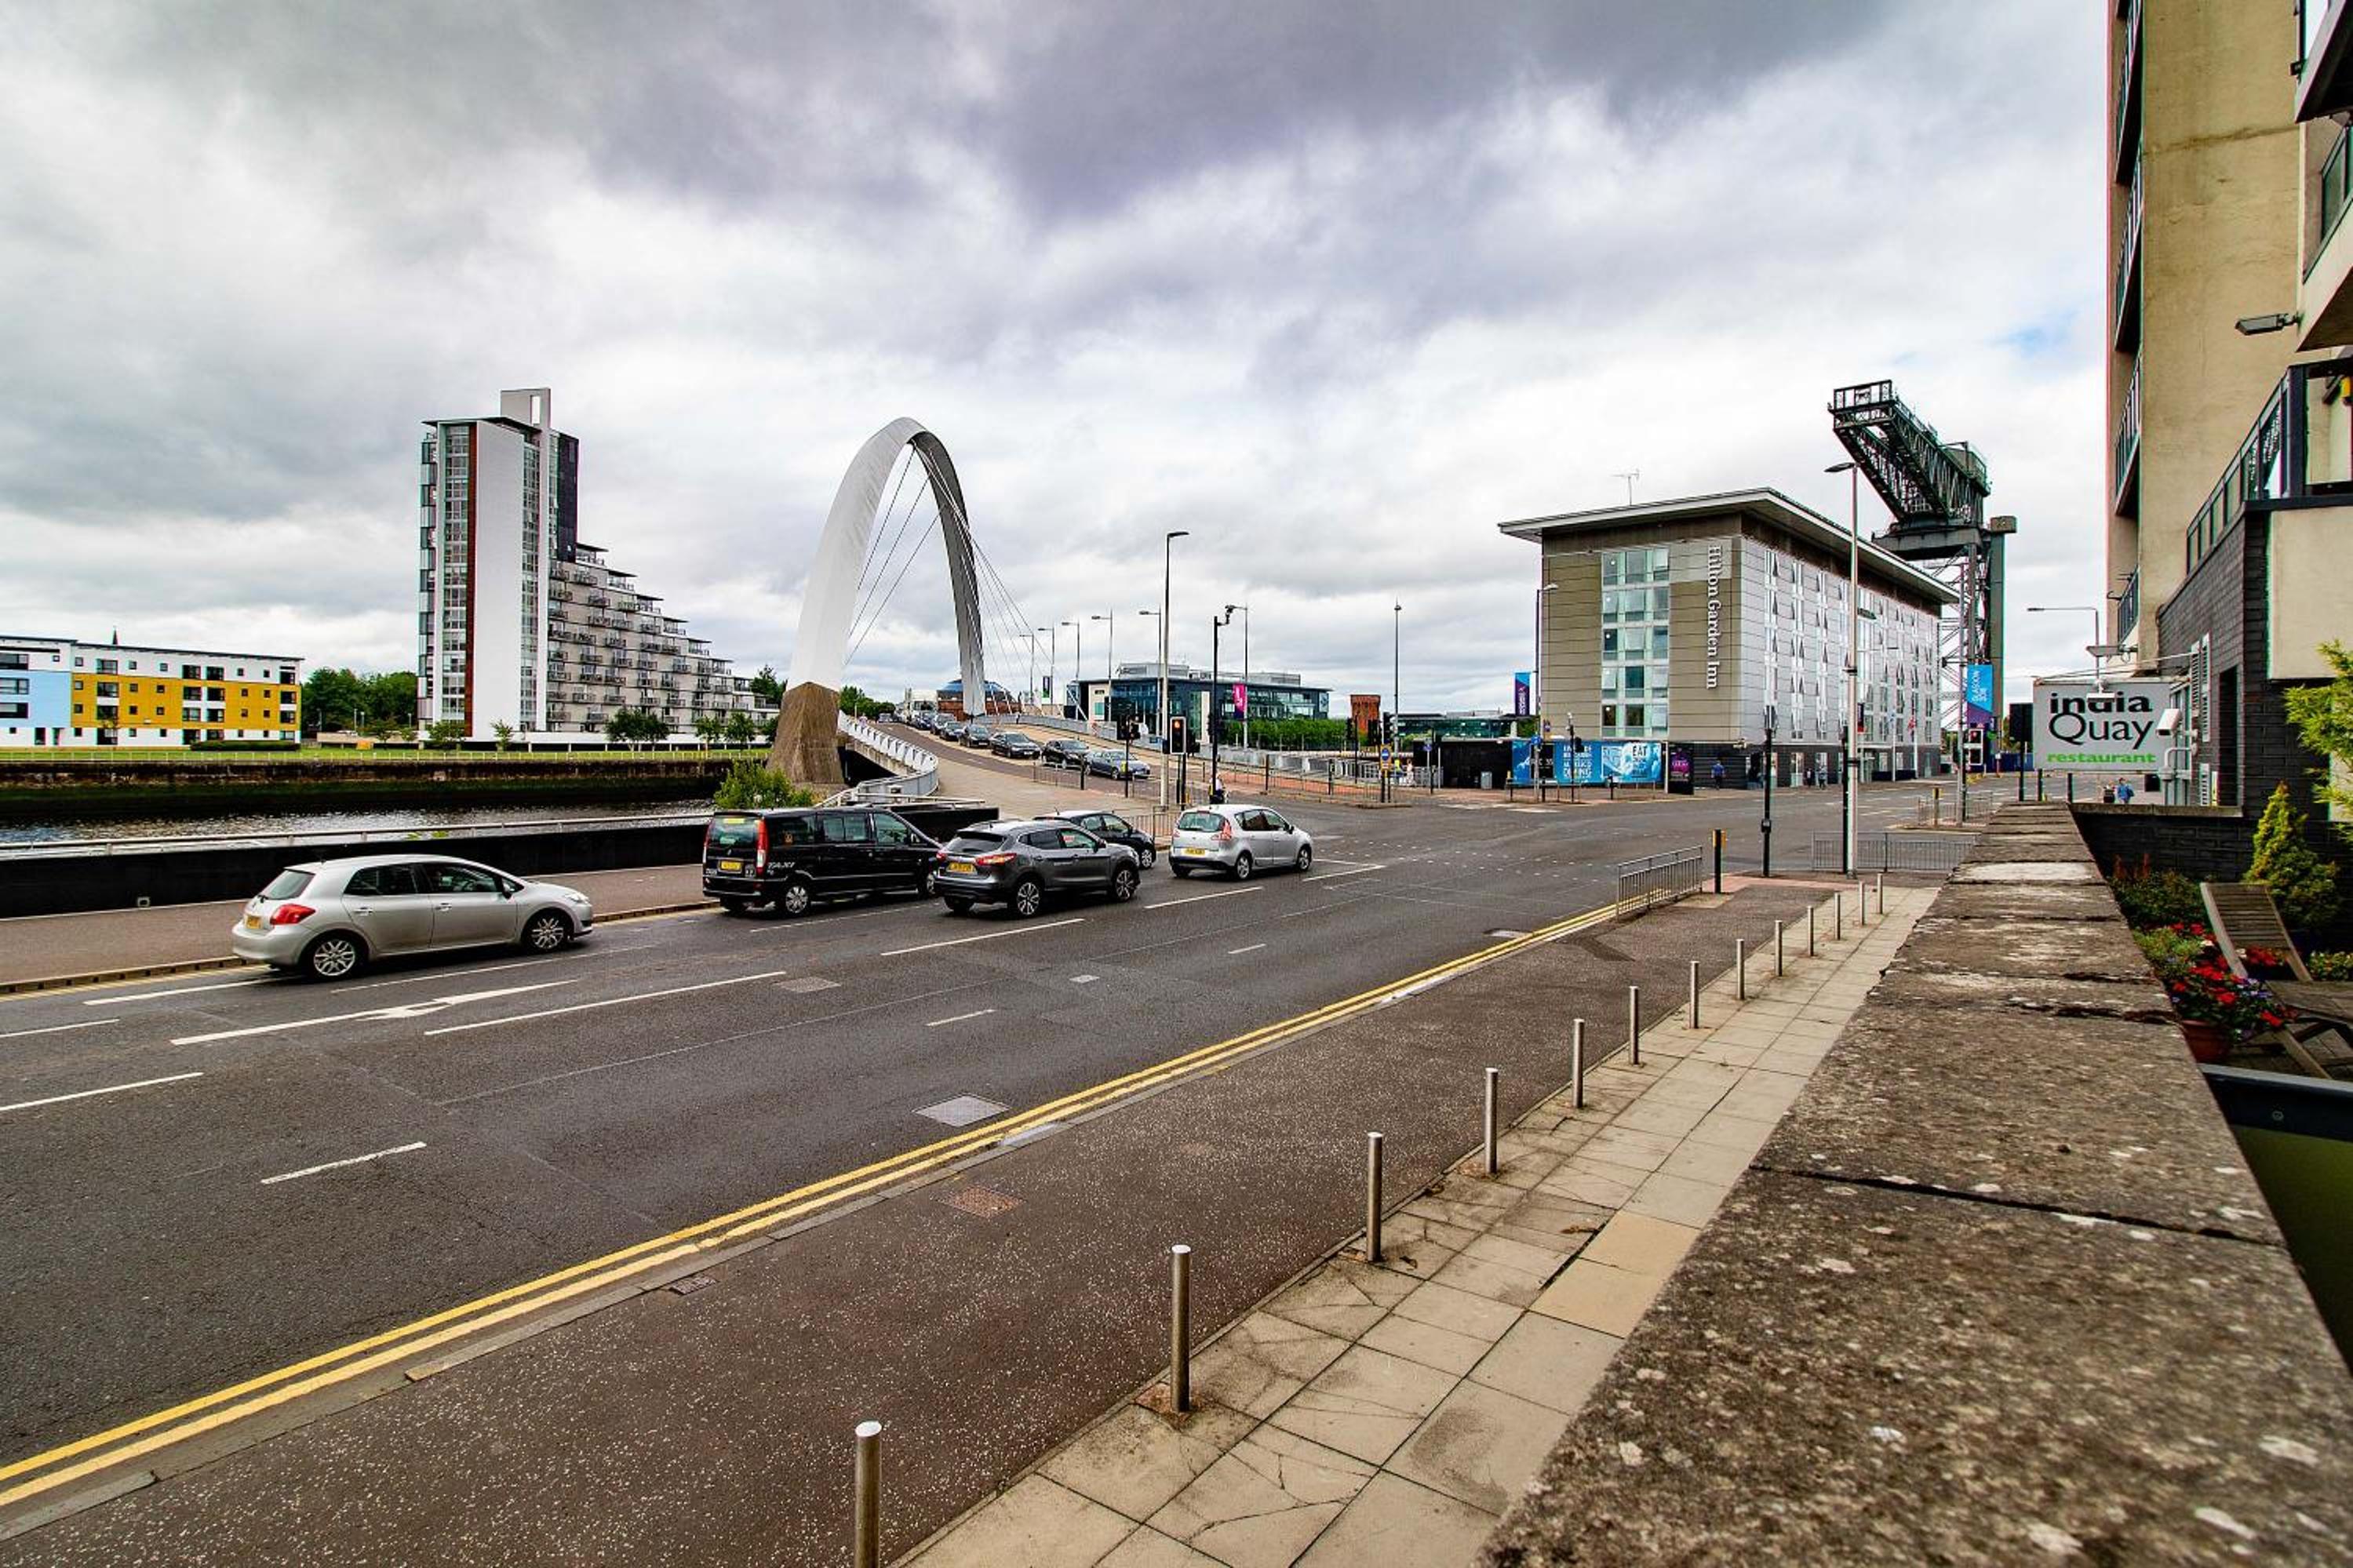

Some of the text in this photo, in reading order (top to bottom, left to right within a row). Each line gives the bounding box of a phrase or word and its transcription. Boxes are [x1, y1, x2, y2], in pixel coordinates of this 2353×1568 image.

[1706, 545, 1722, 689] Hilton Garden Inn
[2049, 713, 2154, 749] Quay
[1632, 744, 1648, 756] EAT
[2047, 752, 2157, 763] restaurant
